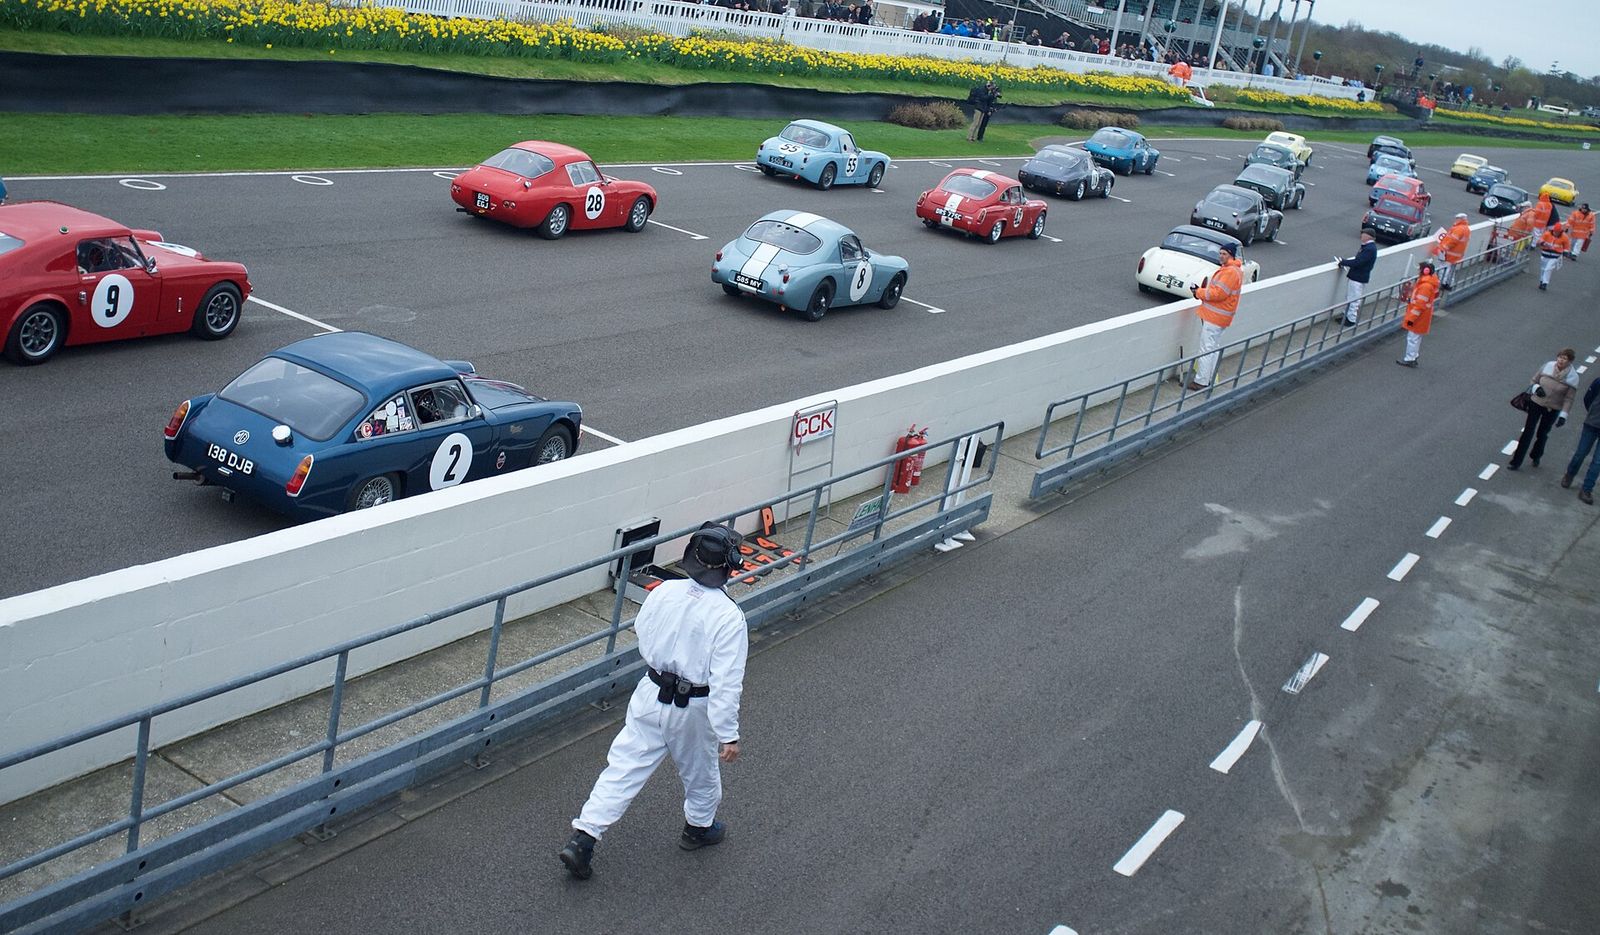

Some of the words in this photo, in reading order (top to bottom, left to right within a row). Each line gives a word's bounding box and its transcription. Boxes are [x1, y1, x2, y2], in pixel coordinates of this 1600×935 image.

[780, 143, 798, 152] 55
[846, 157, 857, 173] 55
[476, 200, 489, 209] EGJ
[477, 192, 490, 202] 609
[587, 193, 603, 212] 28
[736, 275, 749, 285] 585
[749, 279, 762, 288] MY
[856, 267, 866, 290] 8
[105, 285, 120, 318] 9
[795, 410, 833, 438] CCK
[208, 443, 227, 462] 138
[227, 453, 254, 475] DJB
[443, 444, 462, 482] 2
[762, 507, 773, 536] P
